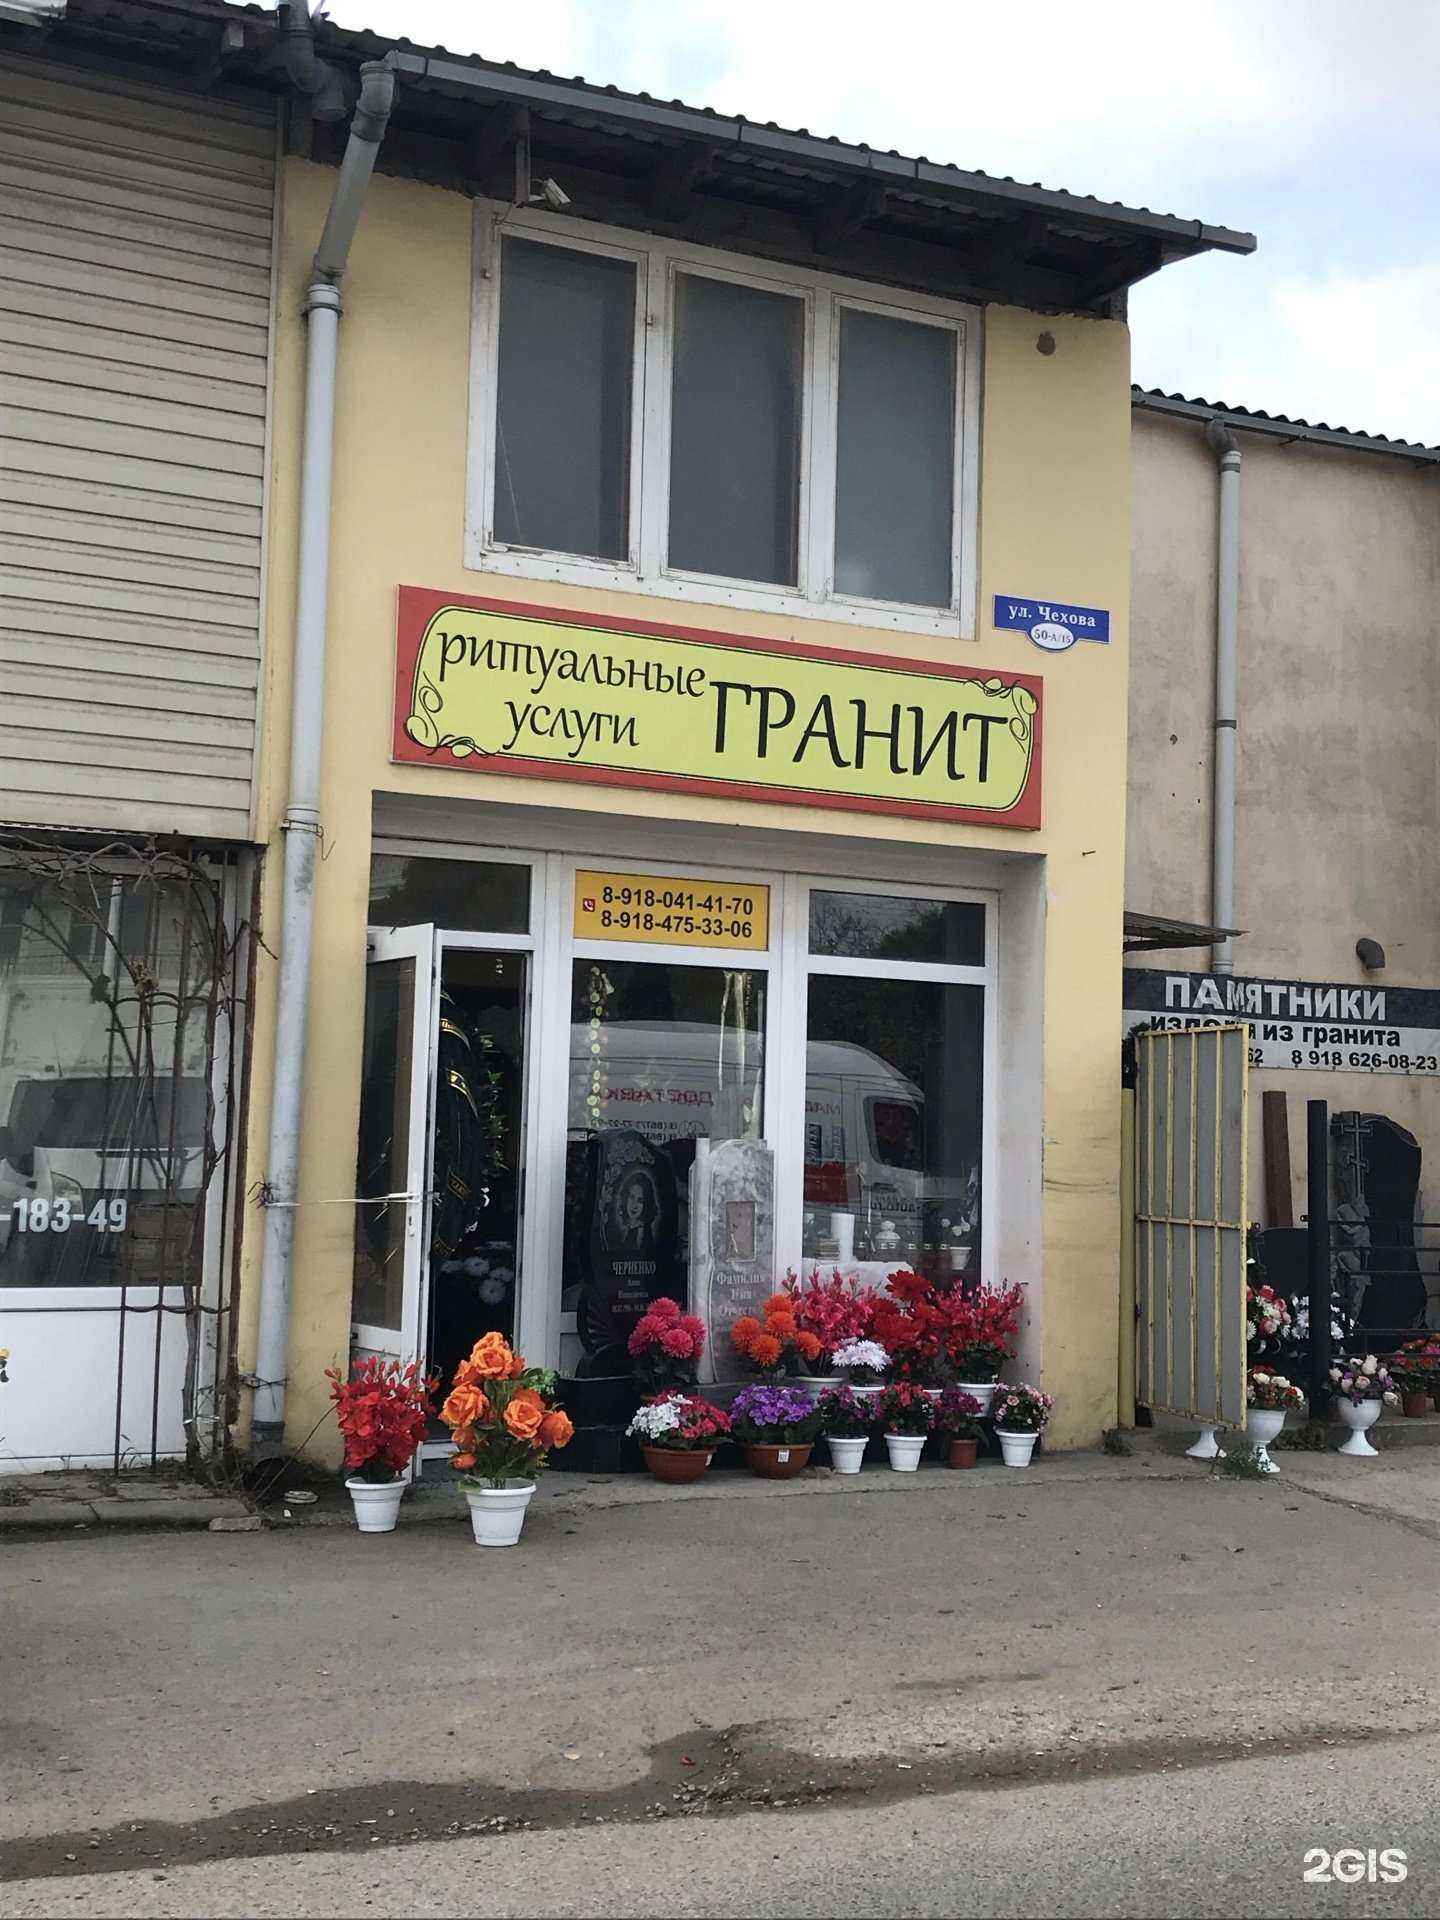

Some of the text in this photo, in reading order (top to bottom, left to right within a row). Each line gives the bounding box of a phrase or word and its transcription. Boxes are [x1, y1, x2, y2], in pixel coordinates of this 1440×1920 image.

[1008, 604, 1097, 627] ул. Чехова
[436, 630, 706, 698] ритуальные
[503, 699, 640, 757] услуги
[709, 680, 1009, 783] ГРАНИТ
[602, 886, 754, 916] 8-918-041-41-70
[601, 910, 753, 938] 8-918-475-33-06
[1164, 975, 1387, 1022] ПАМЯТНИКИ
[1262, 1023, 1294, 1042] из
[1302, 1024, 1401, 1048] гранита
[1291, 1049, 1303, 1065] 8
[1308, 1050, 1343, 1067] 918
[1349, 1052, 1437, 1071] 626-08-23
